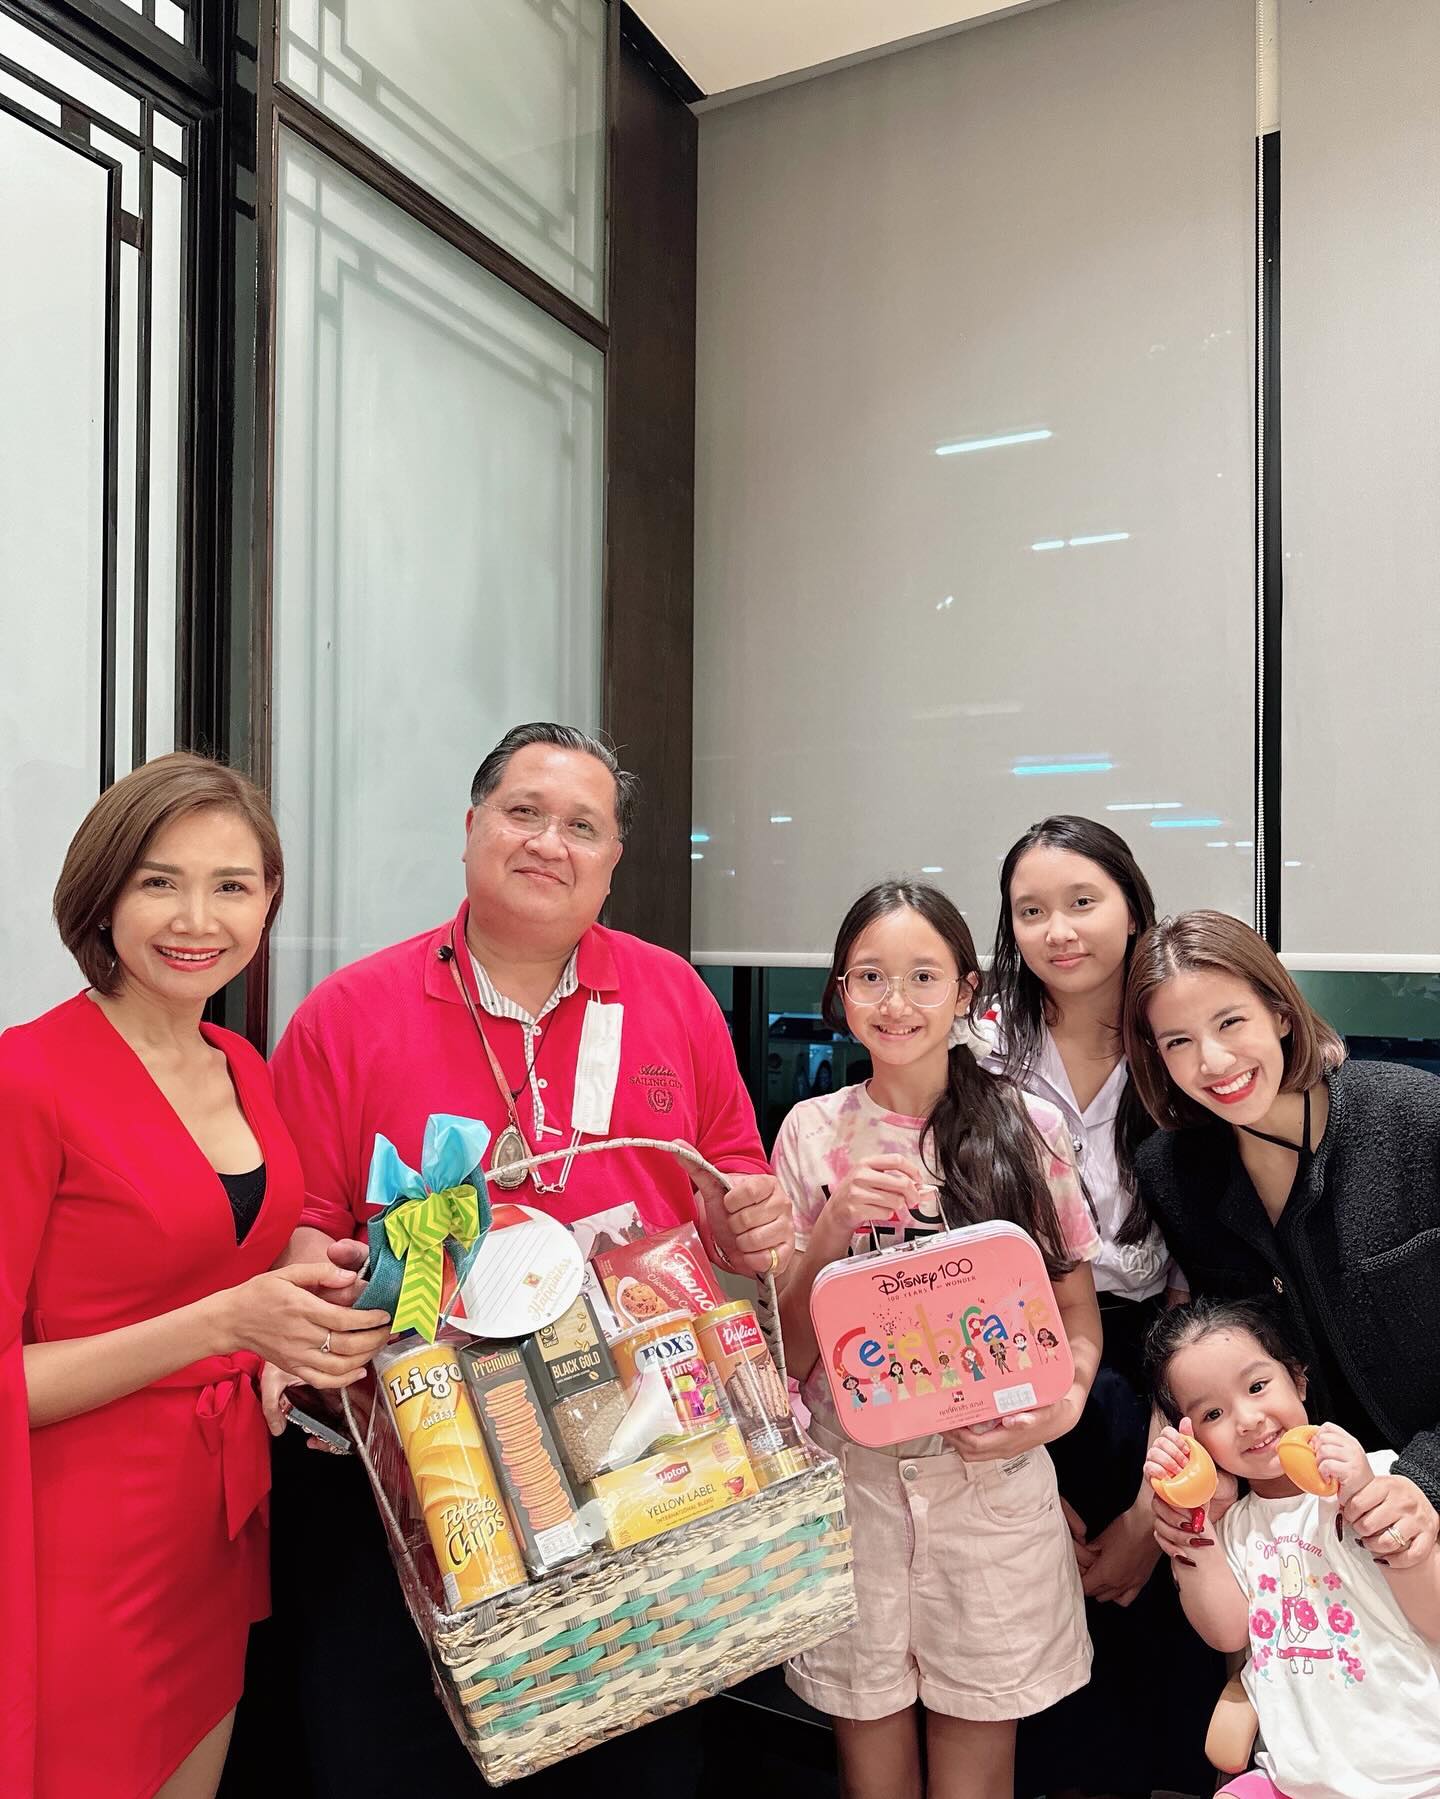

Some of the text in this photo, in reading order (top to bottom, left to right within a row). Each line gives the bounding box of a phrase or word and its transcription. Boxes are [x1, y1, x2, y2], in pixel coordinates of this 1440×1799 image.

[871, 1258, 974, 1295] Disney 100
[903, 1288, 928, 1299] YEARS
[945, 1275, 977, 1288] WONDER
[471, 1350, 521, 1379] Premium
[551, 1358, 580, 1379] BLACK
[578, 1351, 601, 1369] GOLD
[390, 1362, 464, 1408] Ligo
[422, 1409, 457, 1430] CHEESE
[657, 1465, 688, 1485] Lipton
[440, 1494, 497, 1537] Potato
[646, 1483, 717, 1519] YELLOW LABEL
[656, 1504, 697, 1524] INTERNATIONAL
[445, 1507, 506, 1575] Chips
